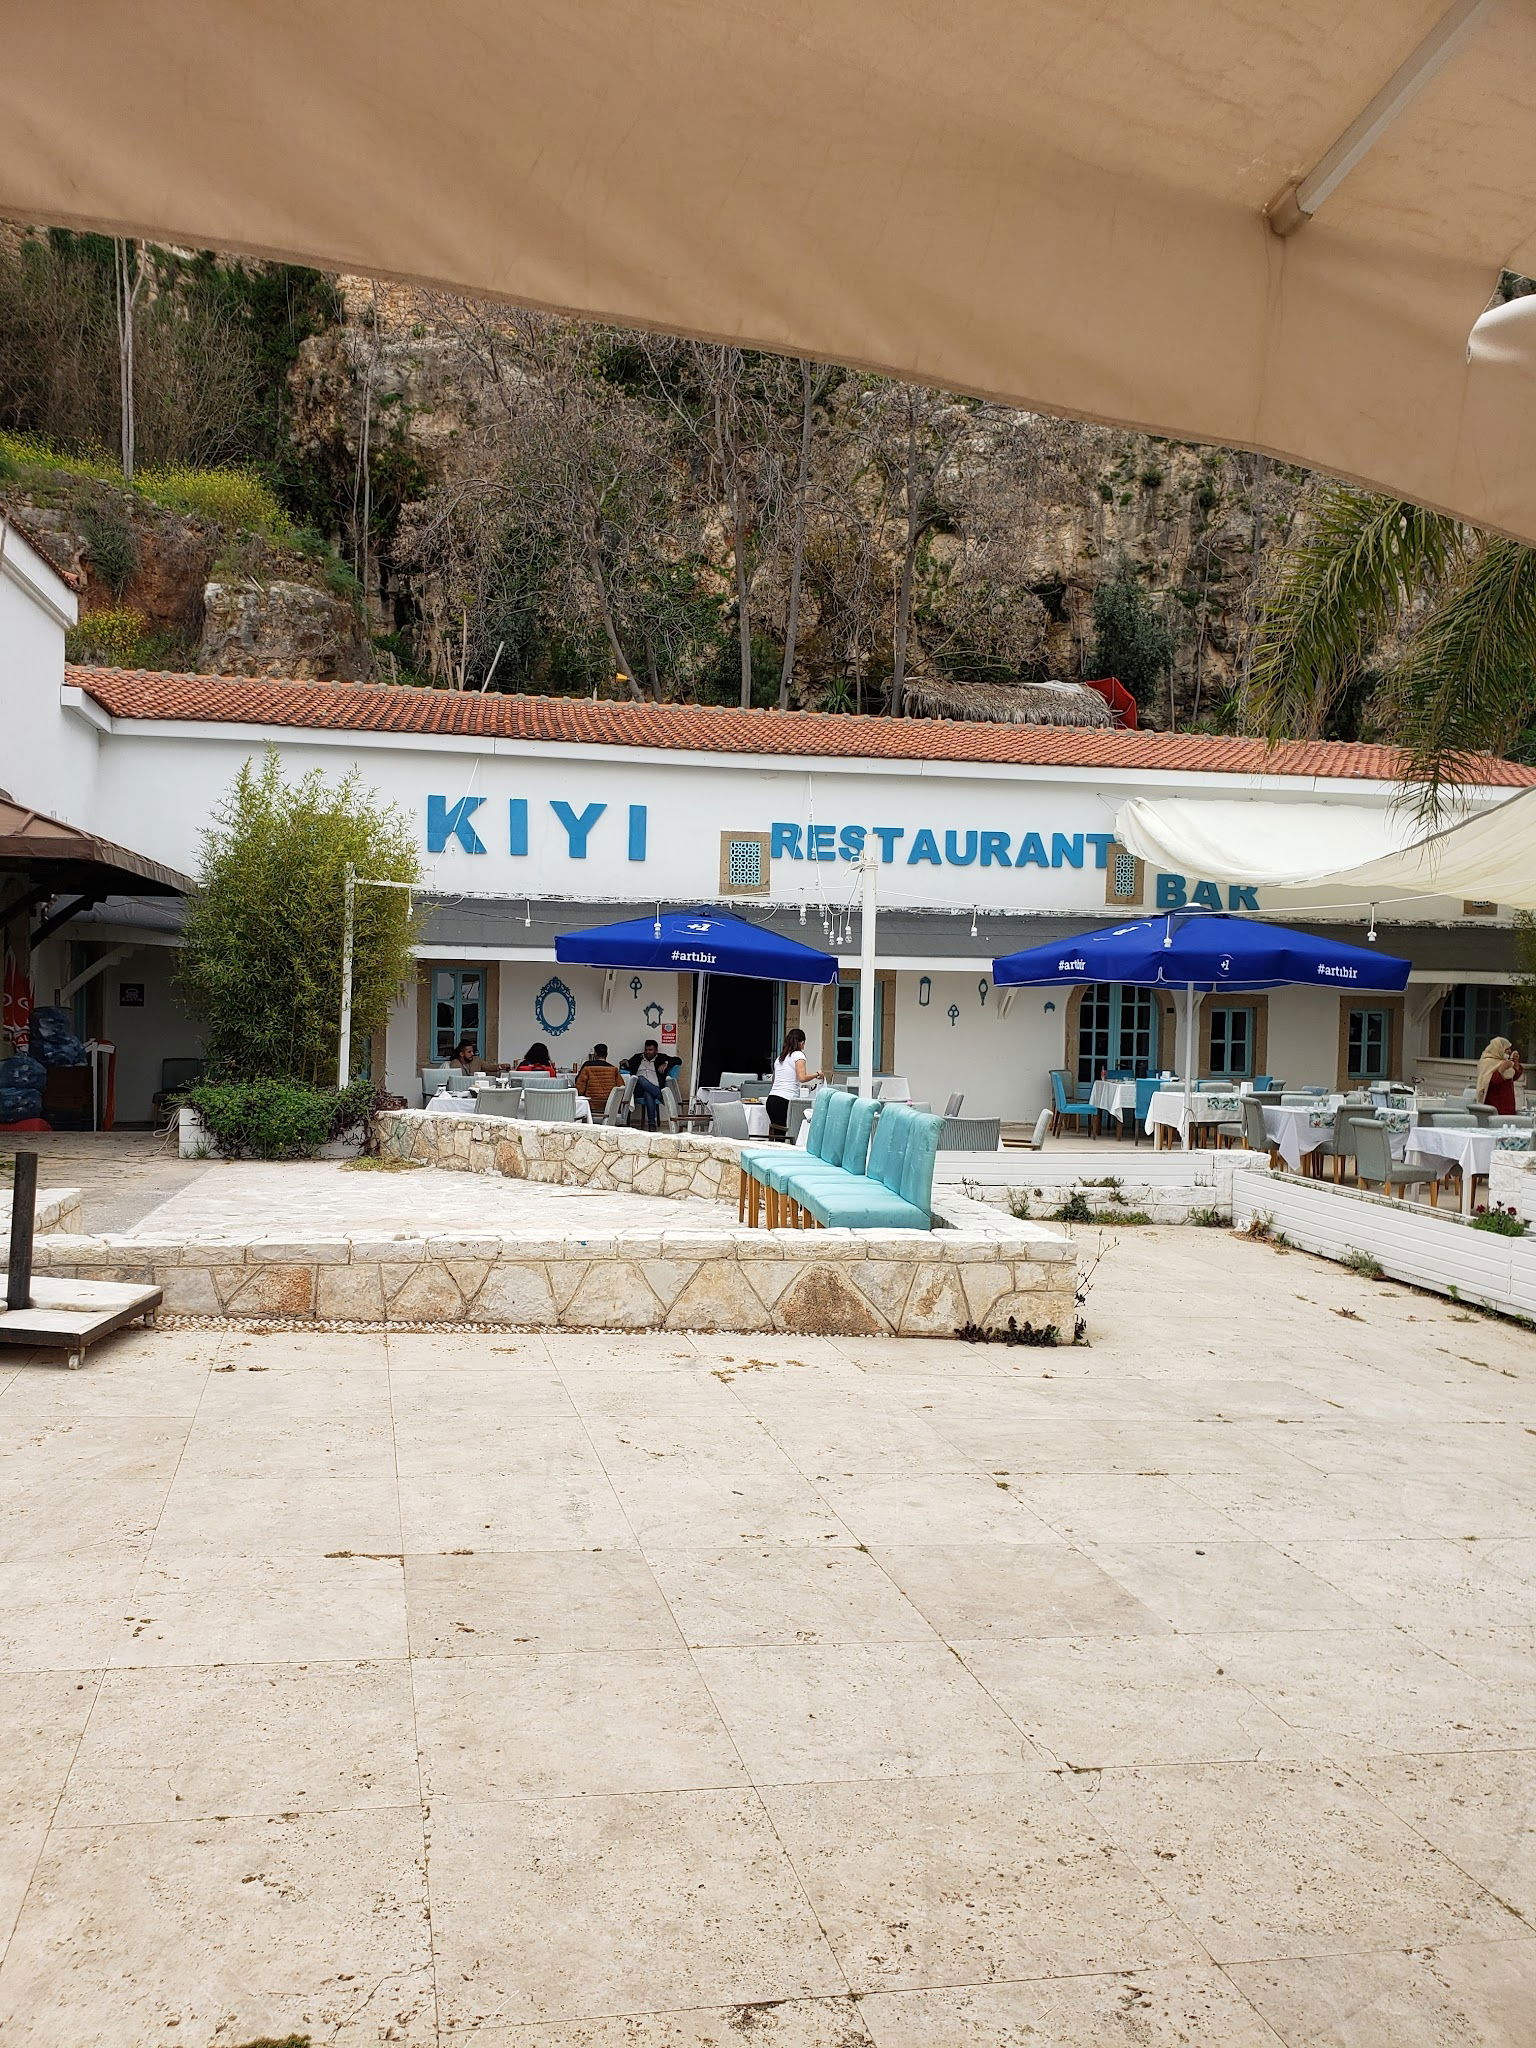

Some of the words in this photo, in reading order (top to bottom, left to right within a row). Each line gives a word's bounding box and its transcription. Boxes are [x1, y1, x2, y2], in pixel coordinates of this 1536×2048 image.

[427, 794, 648, 862] KIYI
[771, 822, 1116, 869] RESTAURANT
[1156, 873, 1260, 911] BAR
